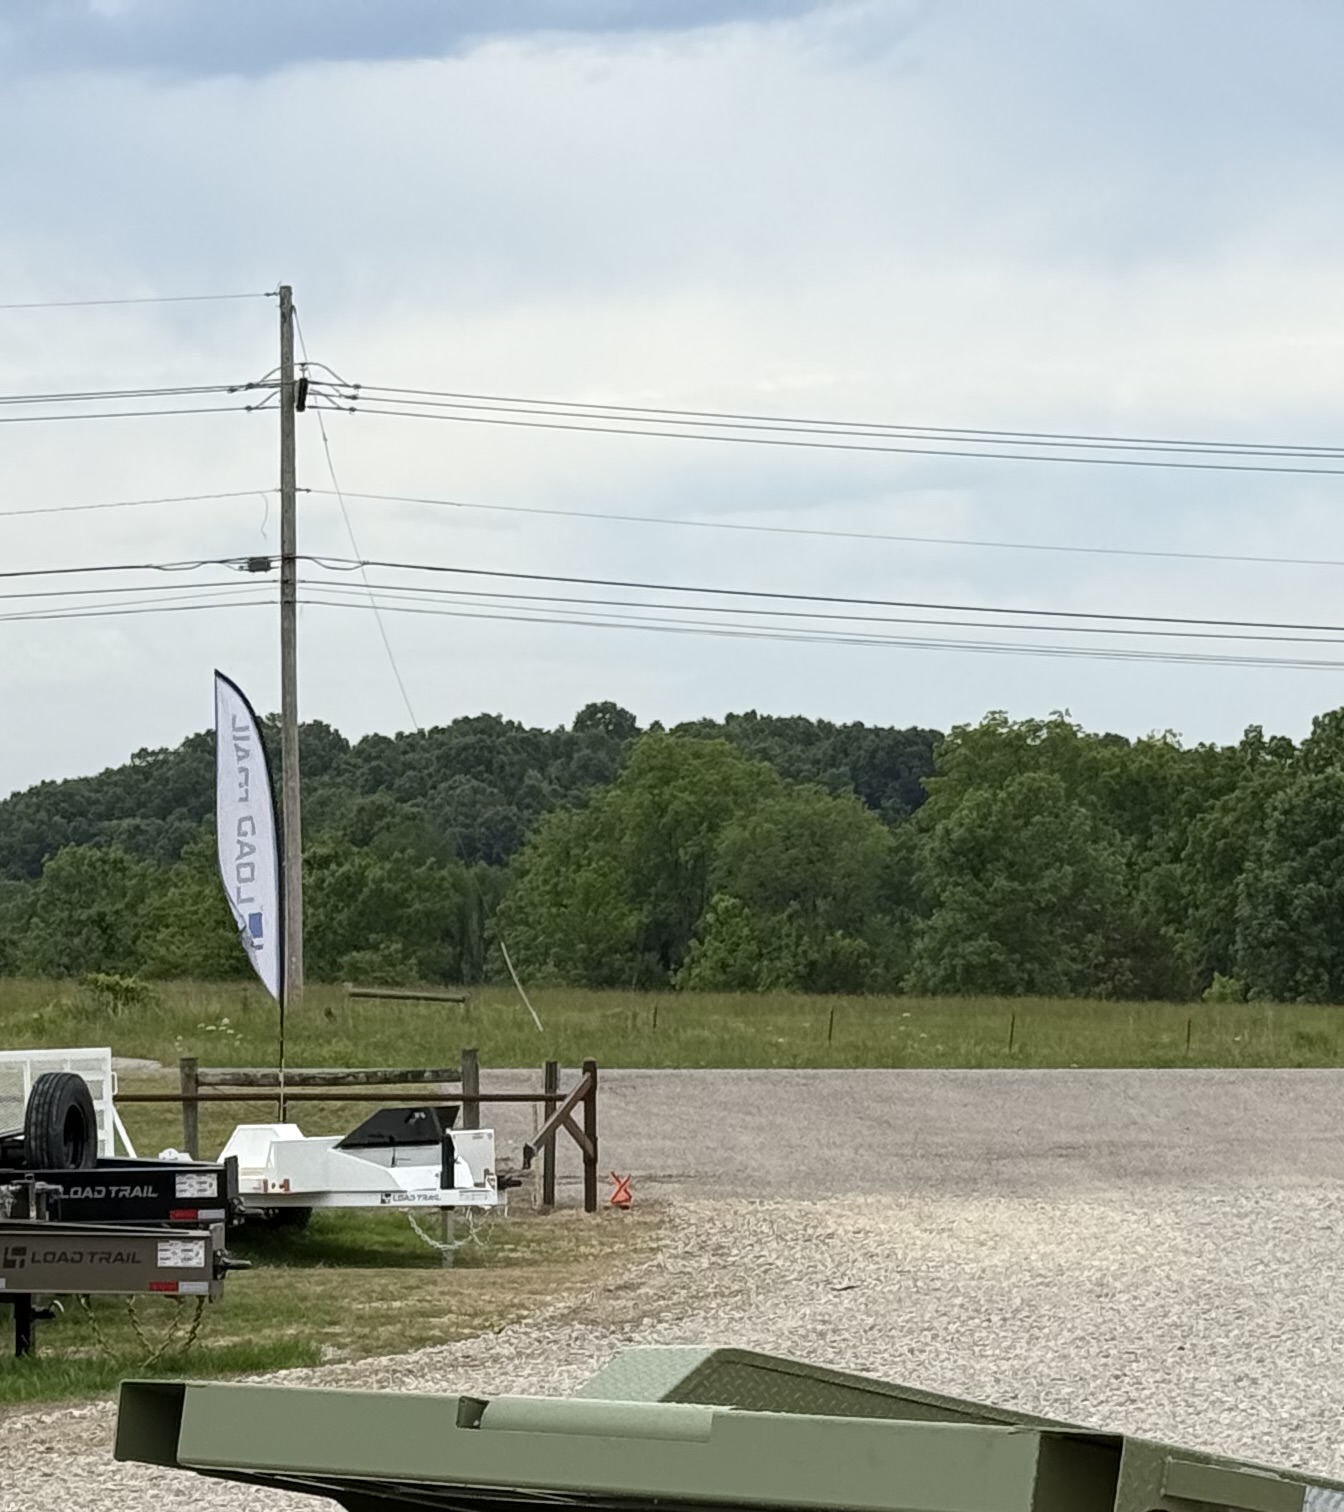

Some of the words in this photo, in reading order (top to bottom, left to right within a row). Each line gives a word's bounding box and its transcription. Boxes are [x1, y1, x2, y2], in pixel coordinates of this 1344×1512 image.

[108, 1185, 159, 1198] TRAIL
[30, 1251, 83, 1264] LOAD
[88, 1250, 143, 1264] TRAIL
